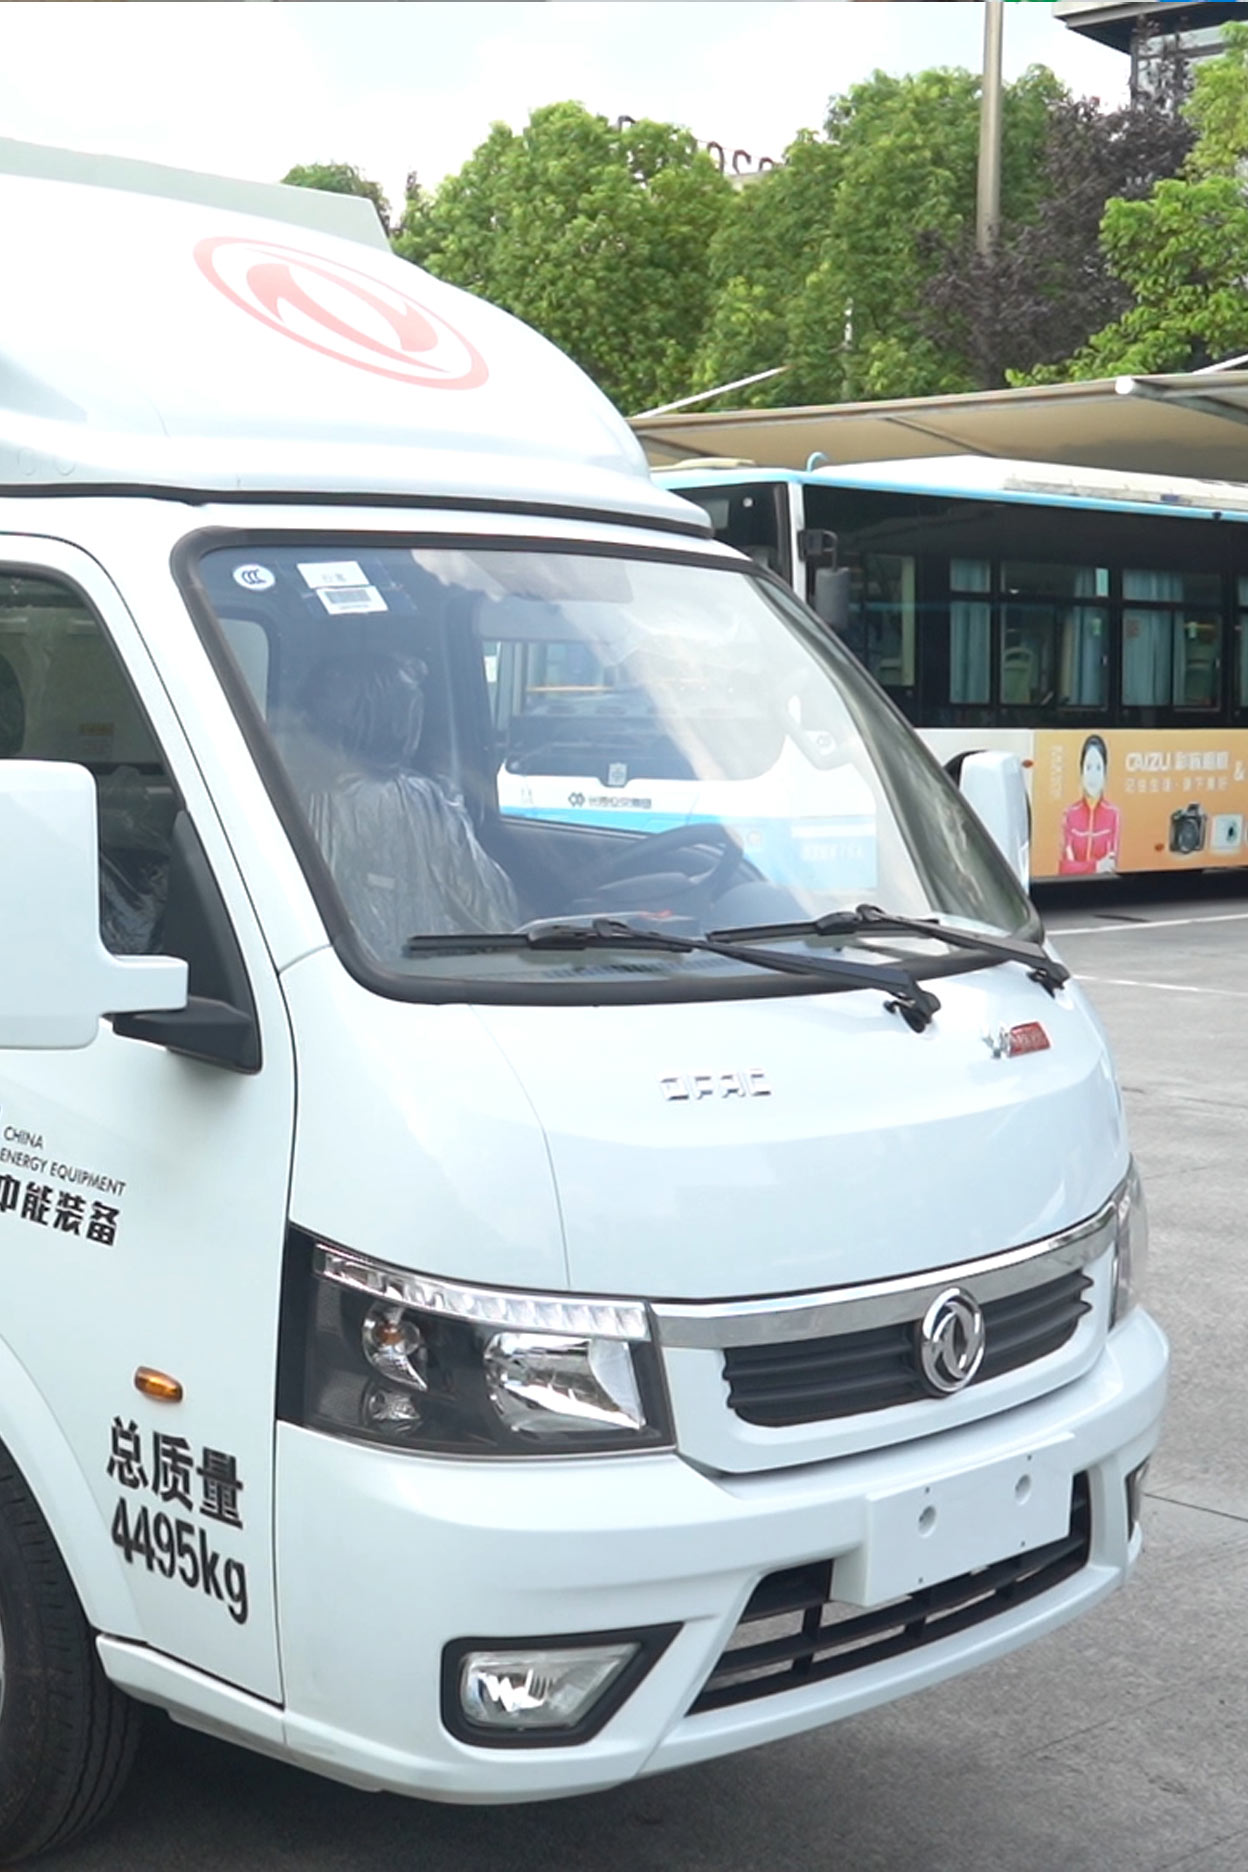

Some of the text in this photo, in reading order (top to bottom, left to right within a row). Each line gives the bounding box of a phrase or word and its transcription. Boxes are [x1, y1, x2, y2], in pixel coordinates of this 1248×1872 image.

[0, 1147, 126, 1196] ENERGY EQUIPMENT
[3, 1126, 44, 1149] CHINA
[106, 1415, 243, 1529] 总质量
[111, 1496, 248, 1625] 4495kg
